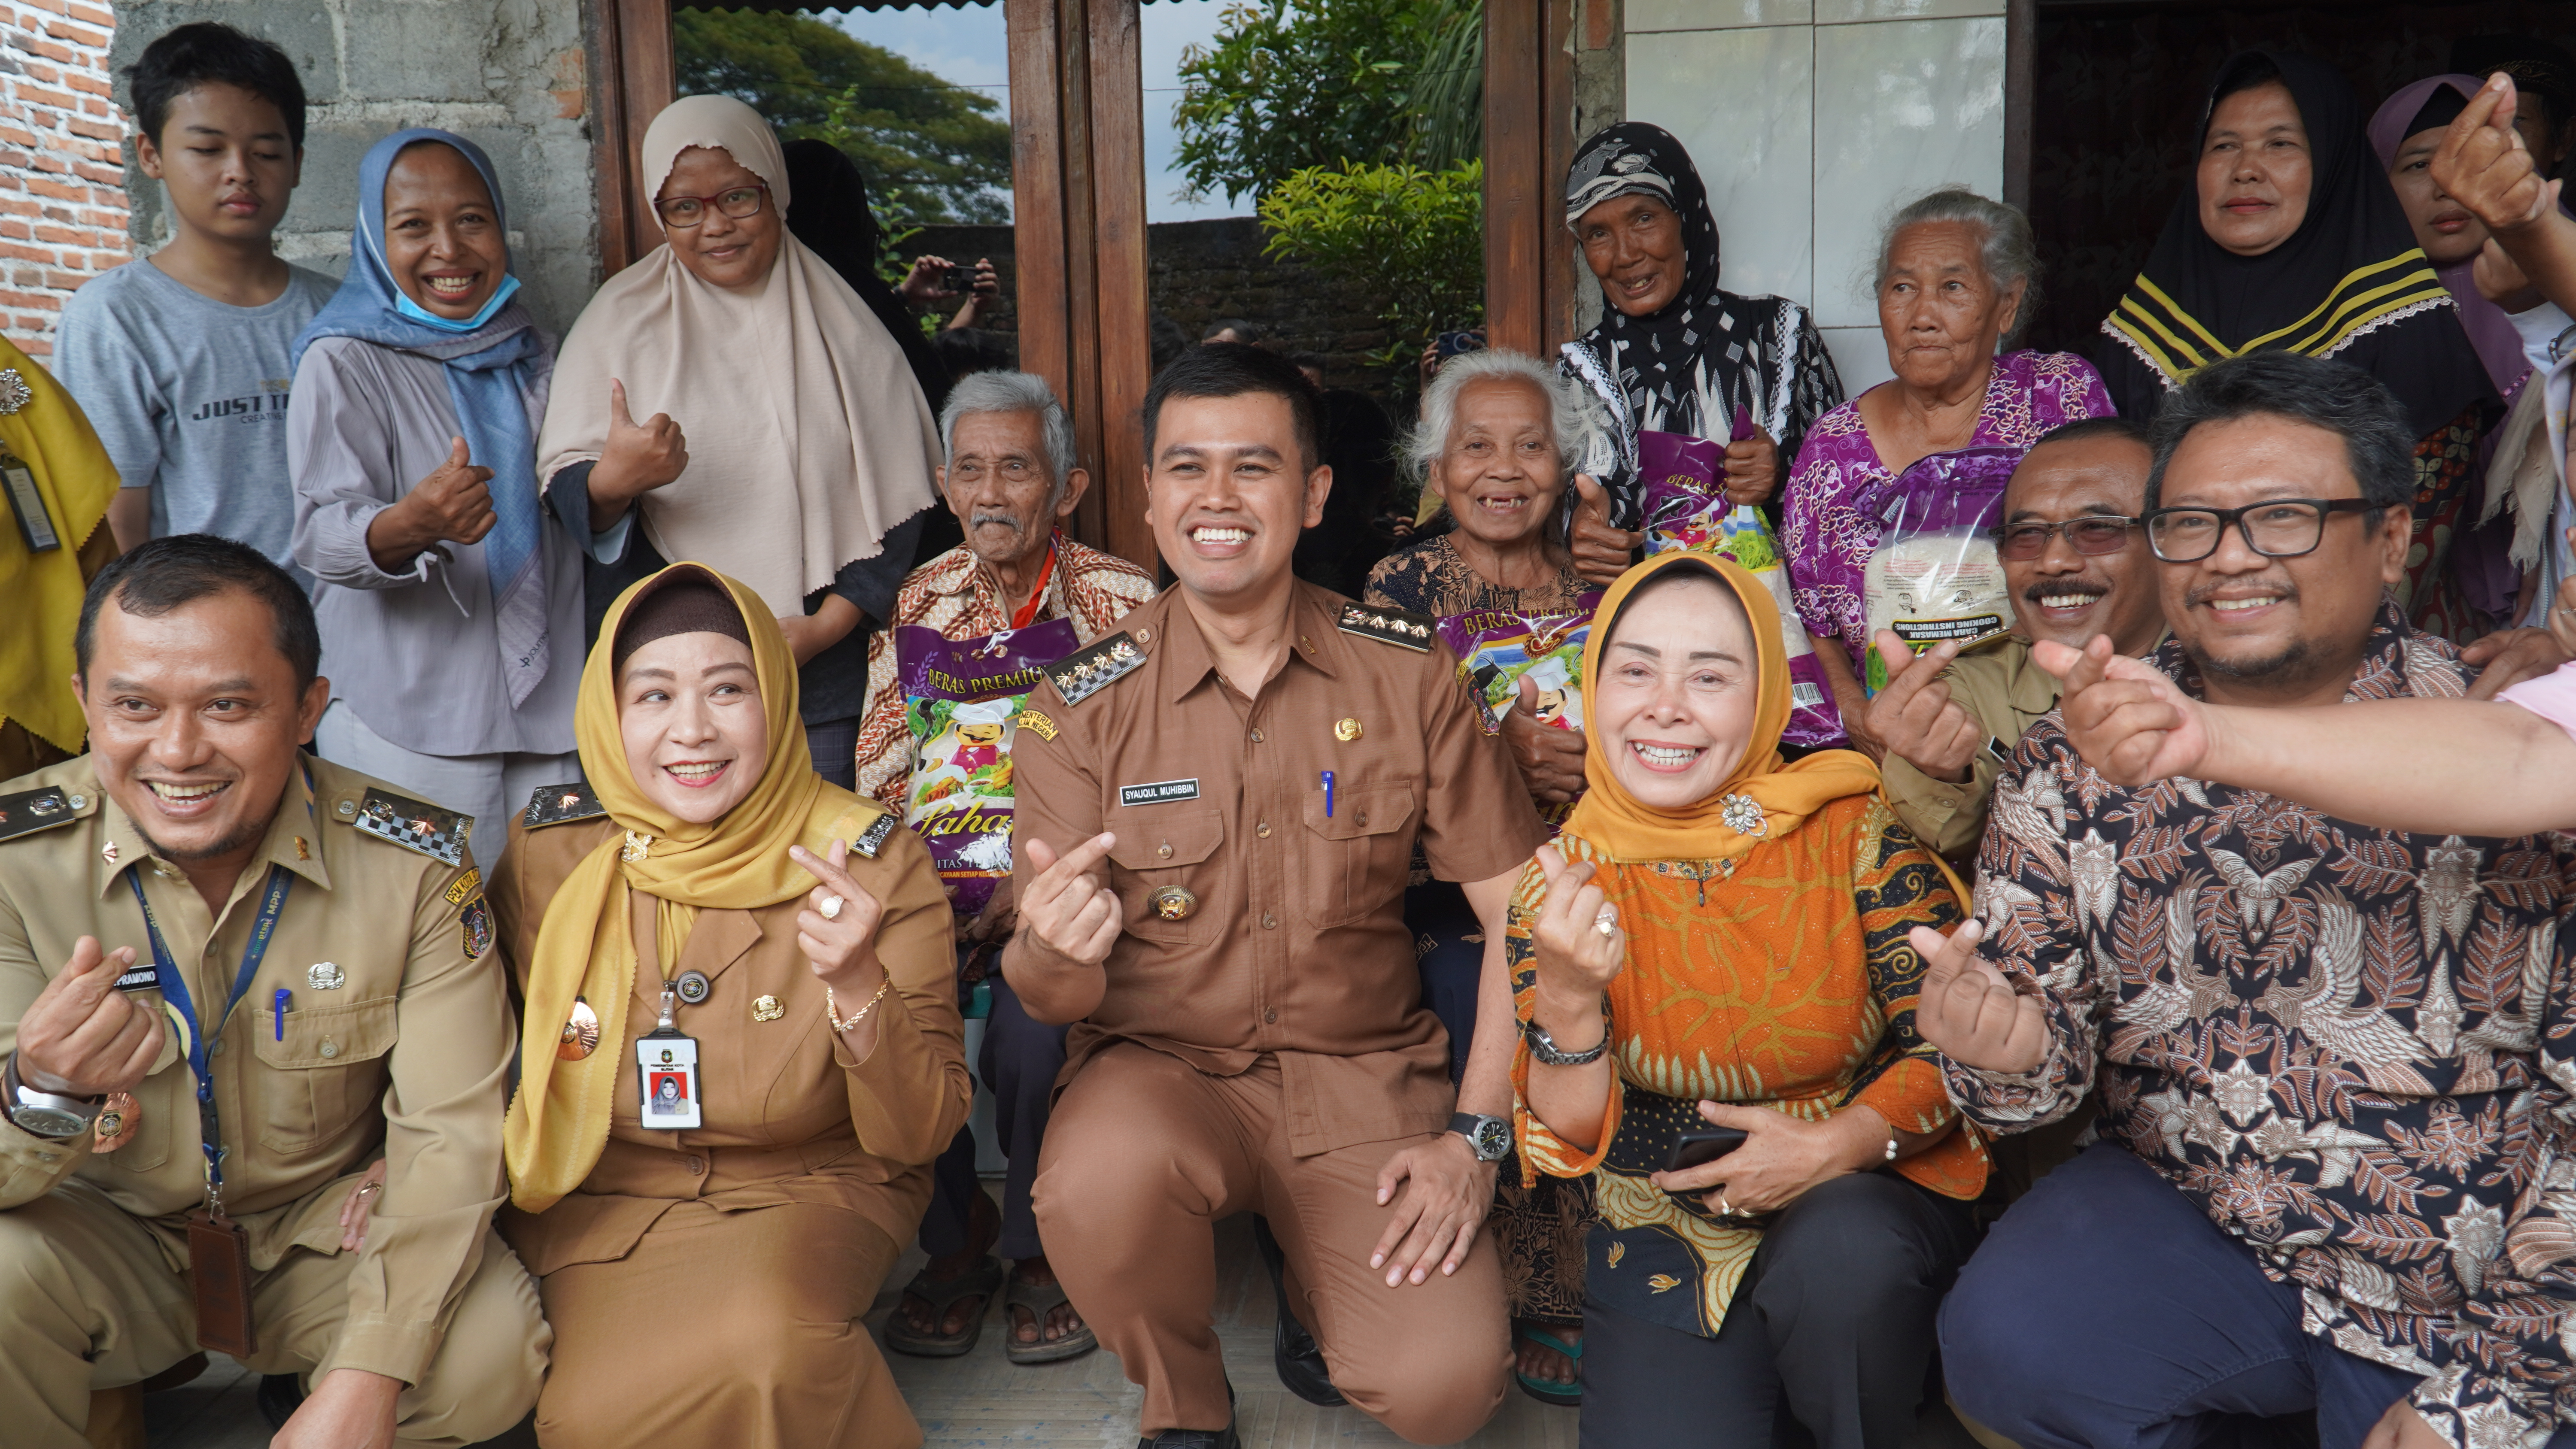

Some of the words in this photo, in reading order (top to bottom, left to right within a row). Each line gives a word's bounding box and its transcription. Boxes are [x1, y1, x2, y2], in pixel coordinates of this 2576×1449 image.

[192, 396, 263, 421] JUST
[1463, 610, 1521, 635] BERAS
[1895, 622, 1955, 631] INSTRUCTIONS:
[1957, 616, 1997, 628] COOKING
[1910, 630, 1952, 639] MEMASAK
[1953, 627, 1978, 637] CARA
[928, 668, 966, 694] BERAS
[969, 665, 1046, 693] PREMIU
[1125, 788, 1157, 800] SYAUQUL
[1160, 784, 1194, 796] MUHIBBIN
[937, 859, 962, 869] ITAS
